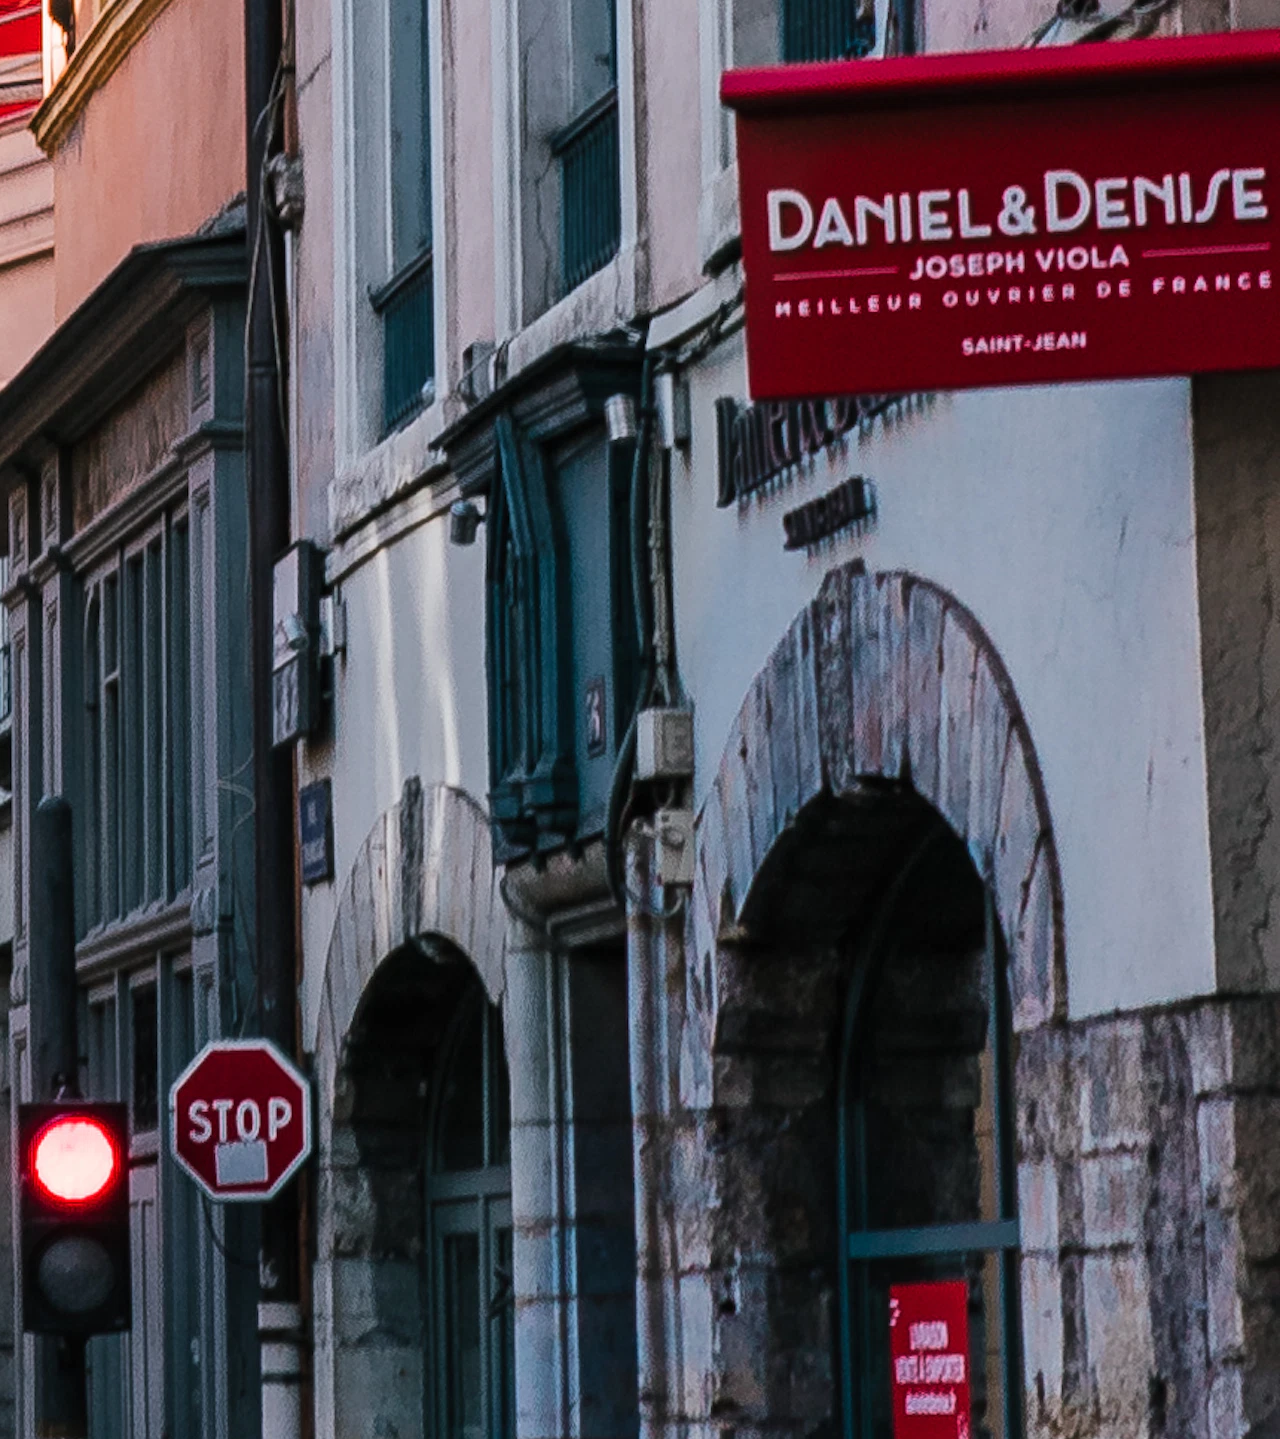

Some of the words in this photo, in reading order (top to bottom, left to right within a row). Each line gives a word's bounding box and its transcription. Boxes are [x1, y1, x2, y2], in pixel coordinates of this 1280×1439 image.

[908, 251, 1026, 281] JOSEPH
[1034, 245, 1130, 273] VIOLA
[774, 292, 924, 319] MEILLEUR
[942, 282, 1077, 309] OUVRIER
[1096, 279, 1133, 299] DE
[1151, 270, 1274, 296] FRANCE
[961, 330, 1088, 357] SAINT-JEAN
[187, 1097, 293, 1144] STOP
